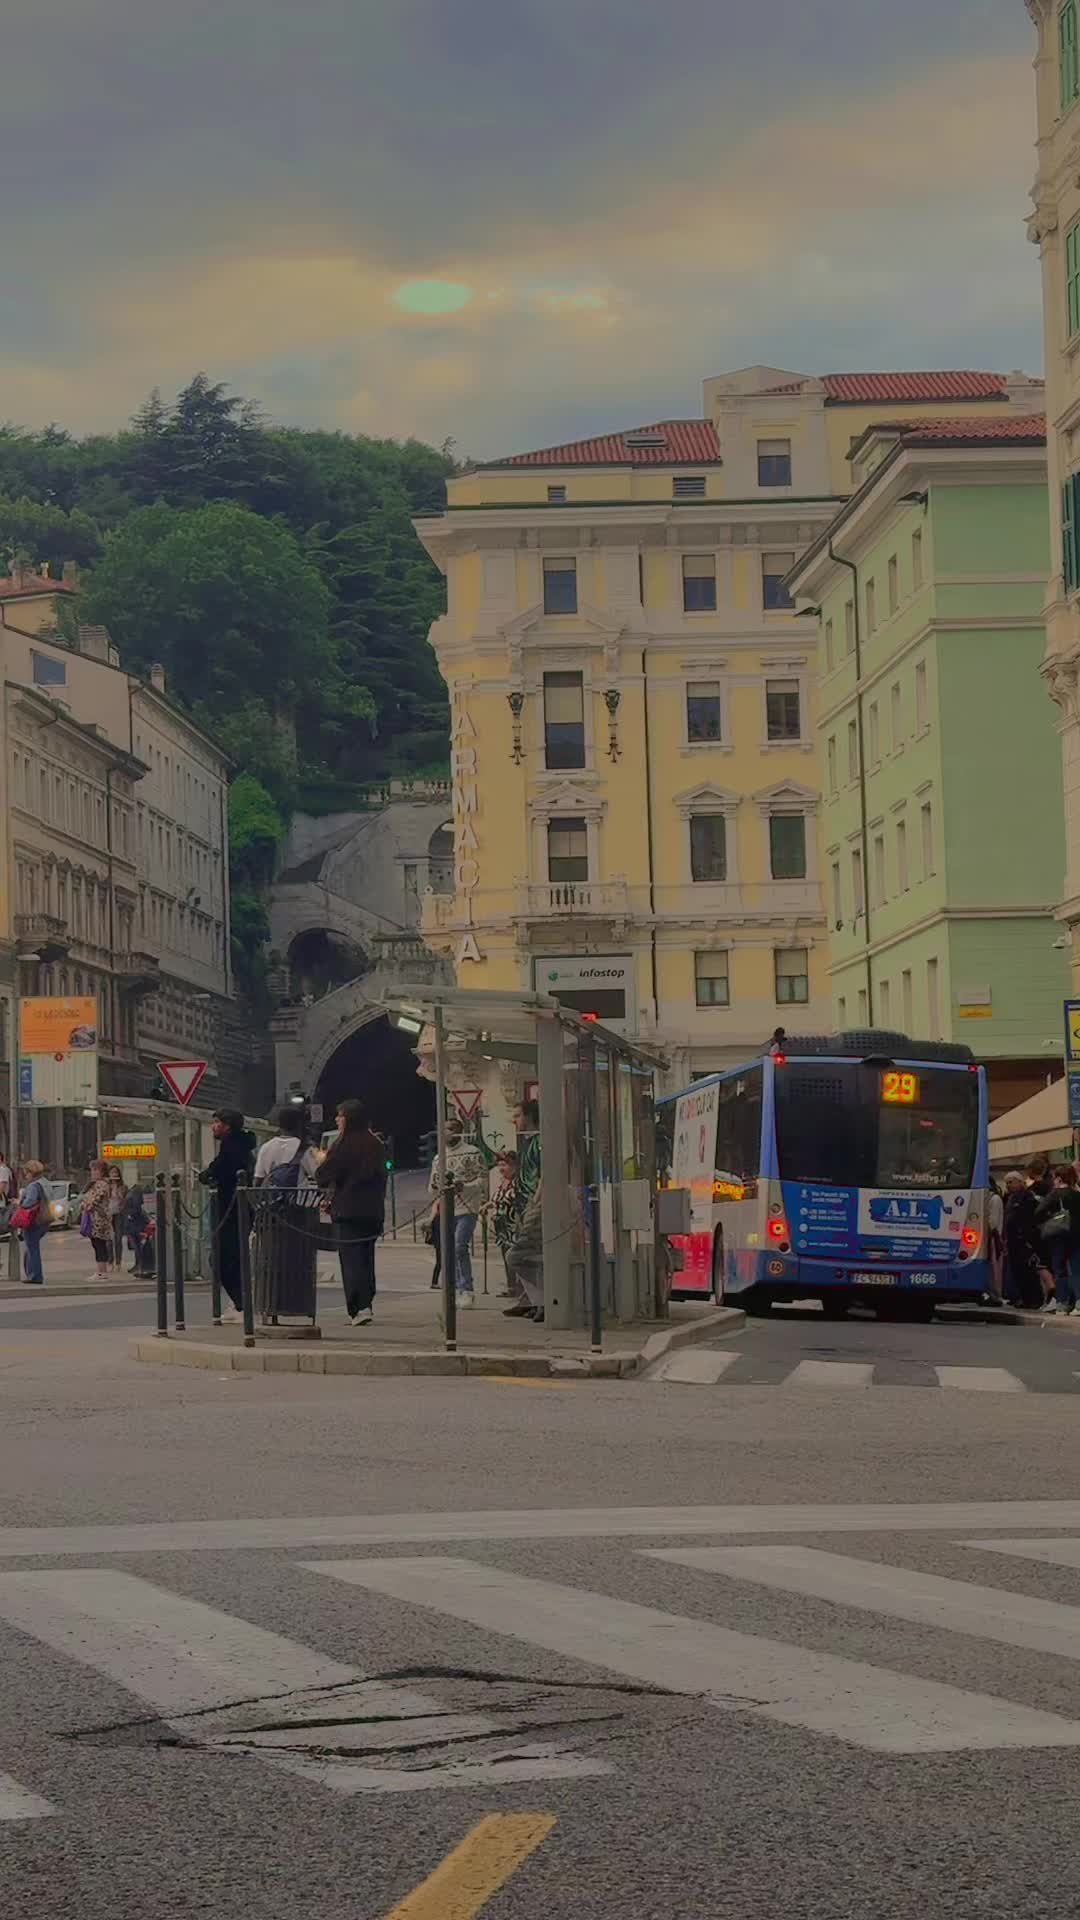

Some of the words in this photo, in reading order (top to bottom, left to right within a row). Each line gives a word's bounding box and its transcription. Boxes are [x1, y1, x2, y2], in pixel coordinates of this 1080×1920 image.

[451, 674, 481, 963] FARMACIA
[579, 968, 625, 979] infostop
[885, 1073, 915, 1100] 29
[885, 1199, 928, 1217] A.L.
[909, 1272, 937, 1284] 1666
